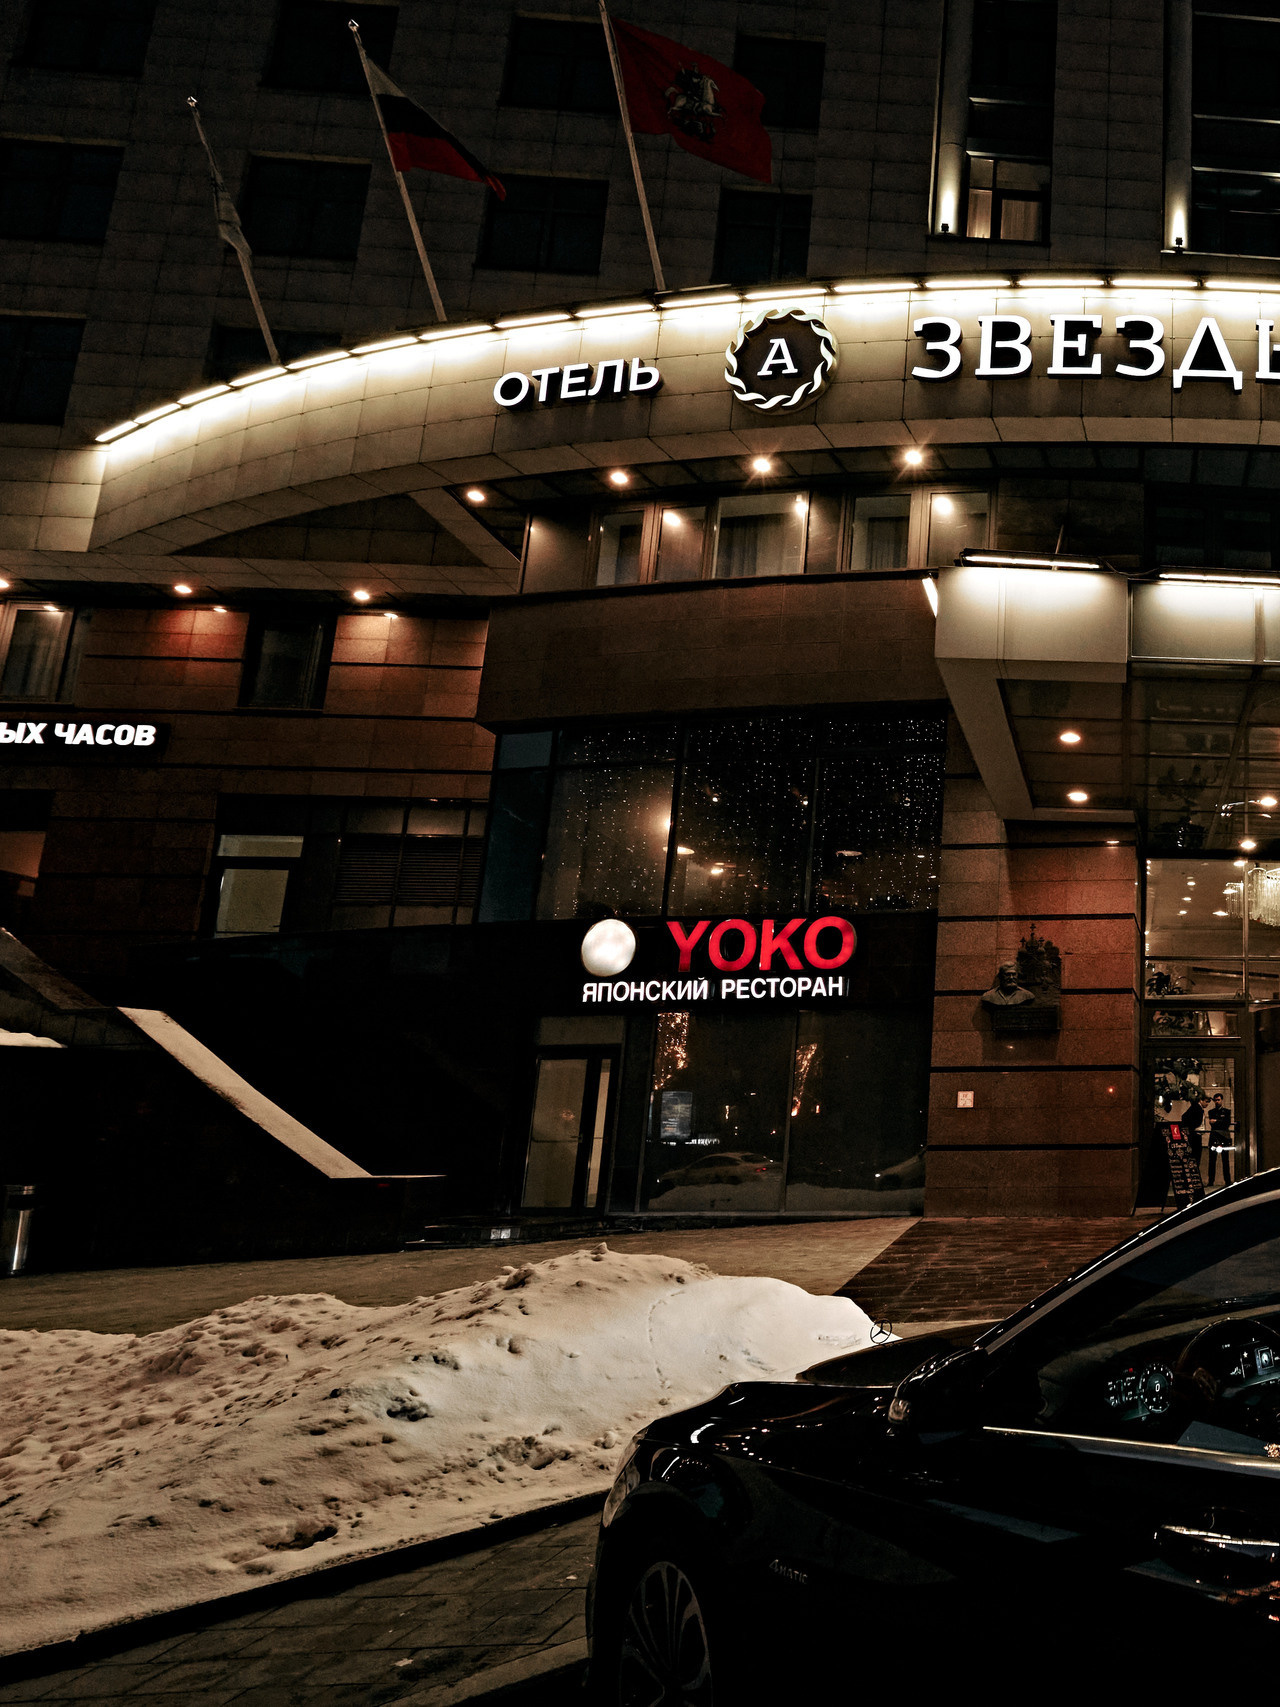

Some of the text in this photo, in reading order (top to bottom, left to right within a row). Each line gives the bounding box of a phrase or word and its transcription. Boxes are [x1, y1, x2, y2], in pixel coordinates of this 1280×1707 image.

[492, 357, 661, 407] ОТЕЛЬ
[54, 723, 157, 746] ЧАСОВ
[666, 916, 856, 973] YOKO
[582, 976, 843, 1002] ЯПОНСКИЙ РЕСТОРАН
